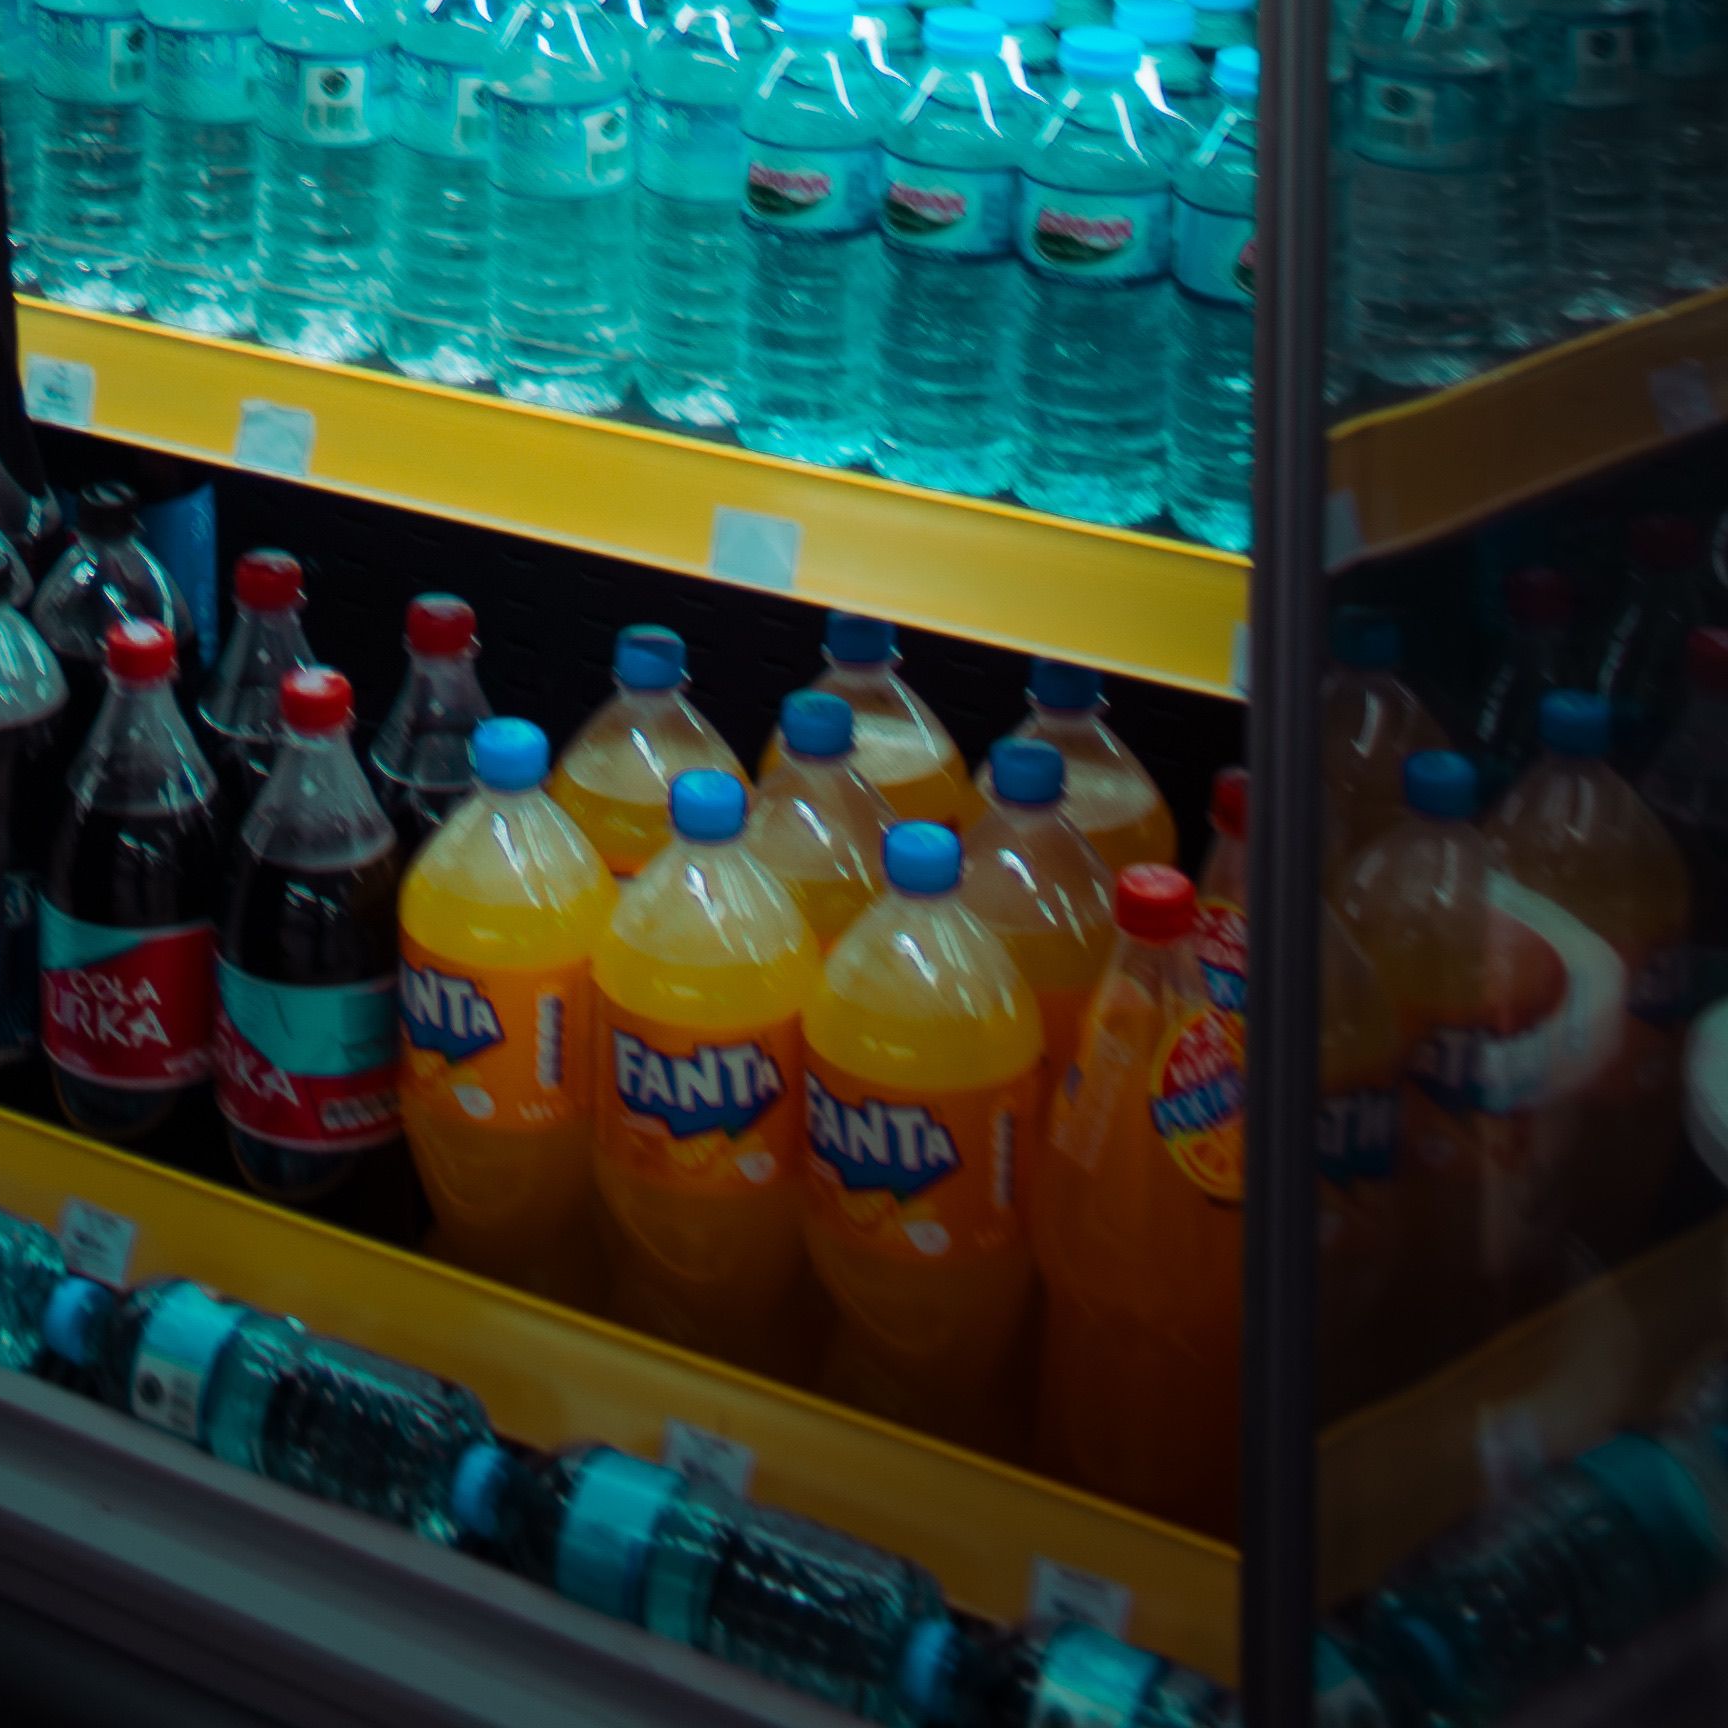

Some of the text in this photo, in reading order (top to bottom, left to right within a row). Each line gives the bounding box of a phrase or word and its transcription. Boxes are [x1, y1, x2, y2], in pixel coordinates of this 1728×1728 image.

[69, 971, 162, 1007] COLA
[611, 1028, 784, 1113] FANTA
[804, 1071, 962, 1171] FANTA
